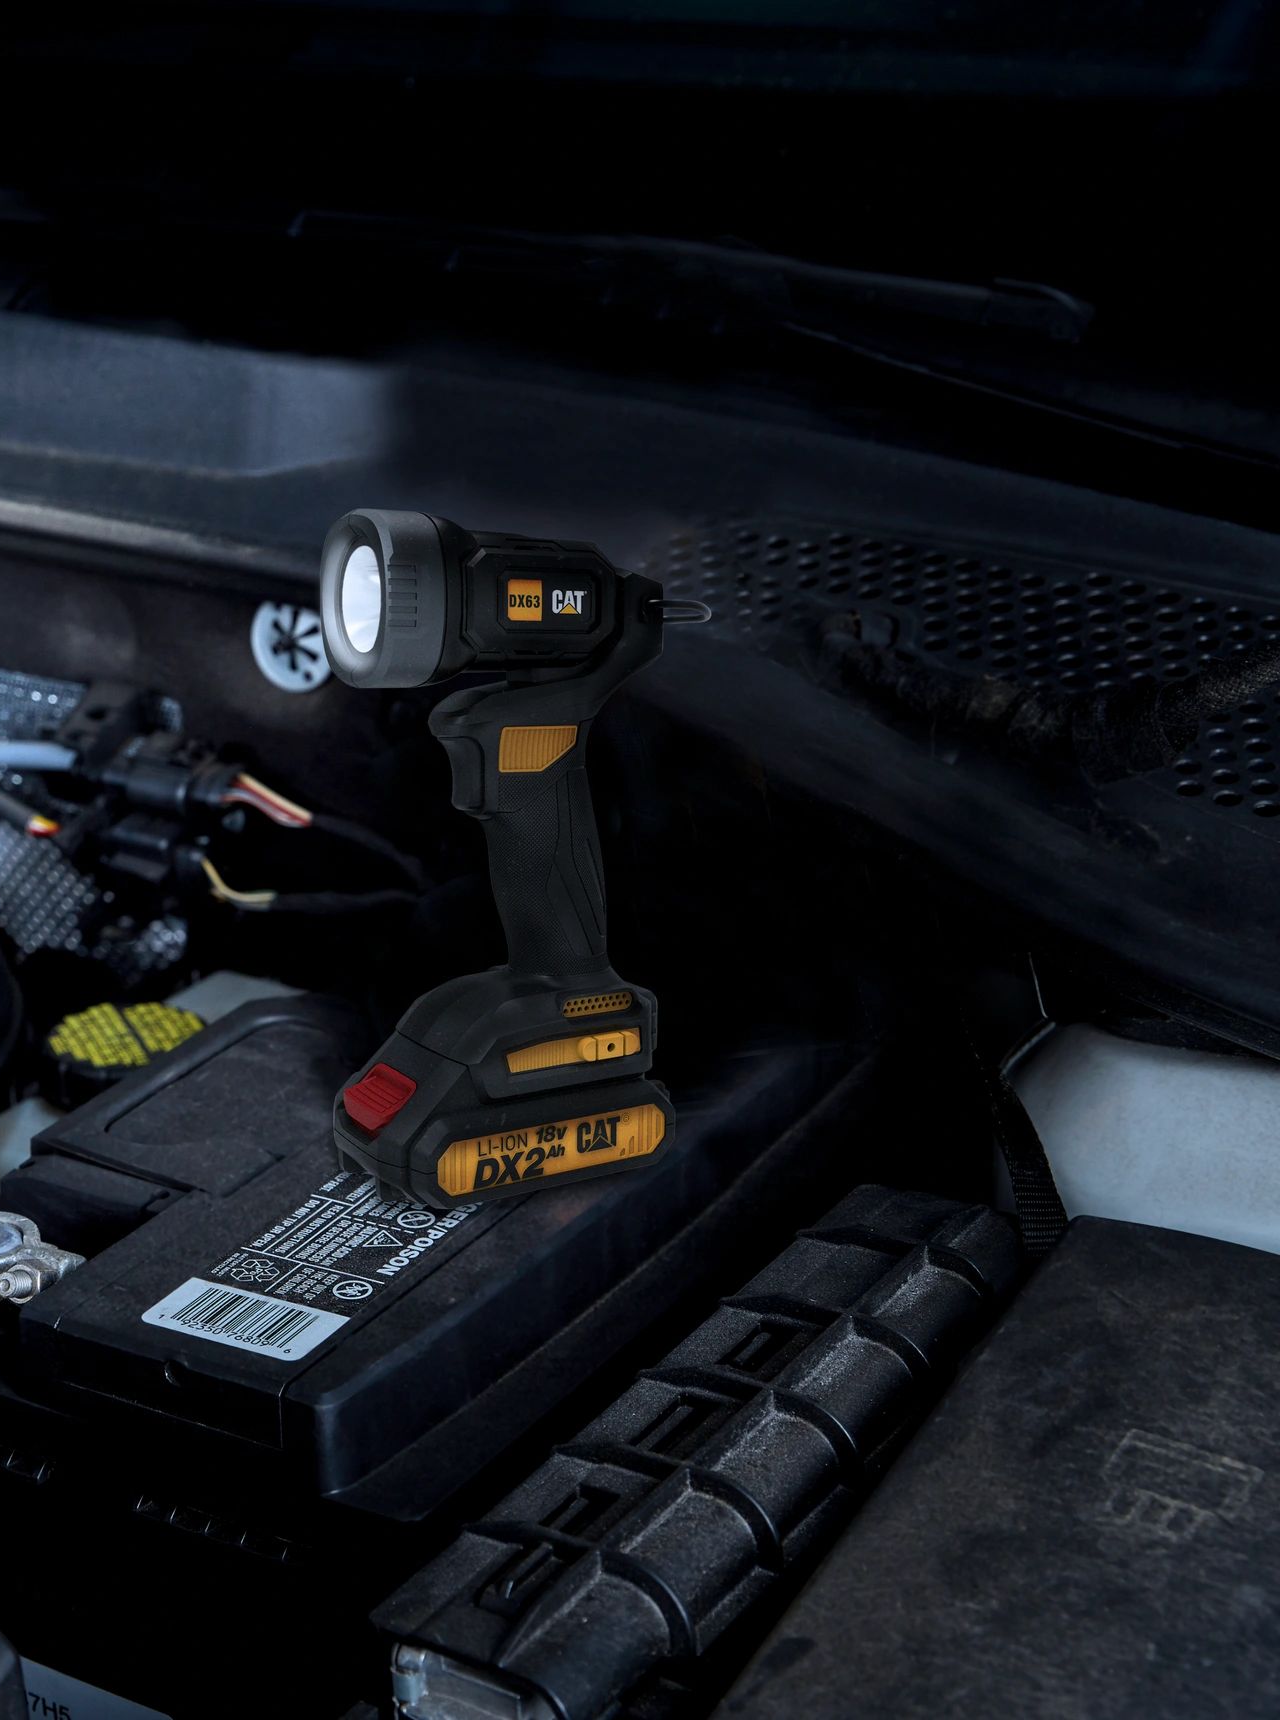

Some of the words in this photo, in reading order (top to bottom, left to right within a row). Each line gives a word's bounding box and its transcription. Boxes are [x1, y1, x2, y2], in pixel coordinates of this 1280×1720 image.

[509, 594, 540, 609] DX63
[552, 590, 585, 615] CAT
[576, 1116, 621, 1154] CAT
[477, 1132, 528, 1157] LI-ION
[303, 1198, 320, 1207] DO
[291, 1205, 310, 1217] NOT
[320, 1203, 343, 1218] READ
[280, 1216, 297, 1226] TIP
[336, 1218, 351, 1227] OR
[270, 1224, 286, 1233] OR
[340, 1221, 364, 1237] CAUSE
[375, 1201, 484, 1277] GER/POISON
[300, 1266, 314, 1274] OF
[310, 1269, 326, 1279] THE
[320, 1272, 339, 1284] KEEP
[302, 1291, 316, 1299] OF
[181, 1320, 223, 1335] 92350
[227, 1332, 270, 1347] 76809
[24, 1690, 72, 1720] 7H5
